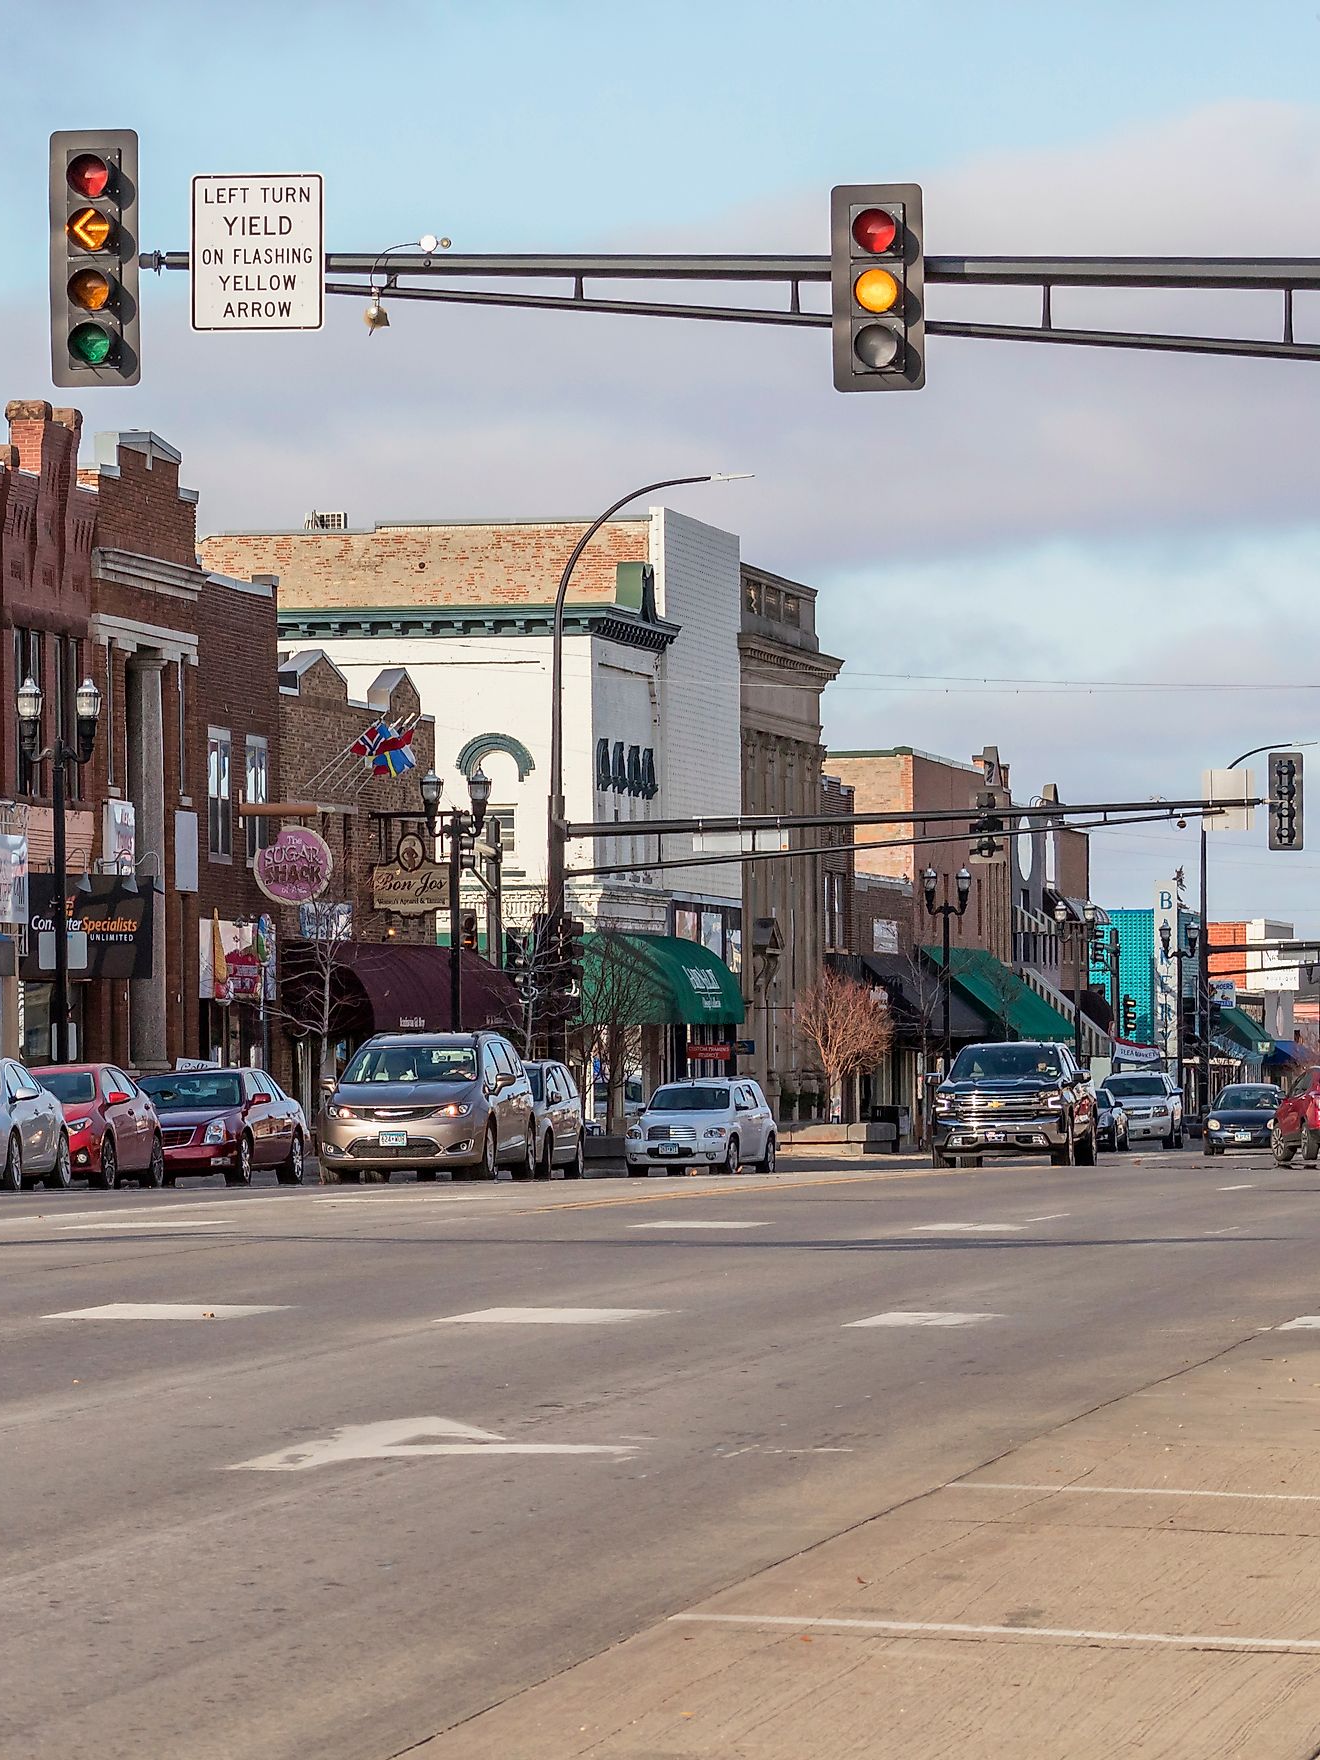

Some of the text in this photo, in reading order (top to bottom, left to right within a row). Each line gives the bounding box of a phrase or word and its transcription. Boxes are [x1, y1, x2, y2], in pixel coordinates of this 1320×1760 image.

[204, 186, 311, 204] LEFT TURN
[223, 216, 293, 236] YIELD
[202, 247, 313, 265] ON FLASHING
[219, 274, 296, 292] YELLOW
[223, 301, 292, 318] ARROW
[286, 835, 302, 845] The
[264, 845, 323, 866] SUGAR
[264, 863, 323, 886] SHACK
[375, 871, 448, 897] Bon Jos
[90, 933, 134, 942] UNLIMITED
